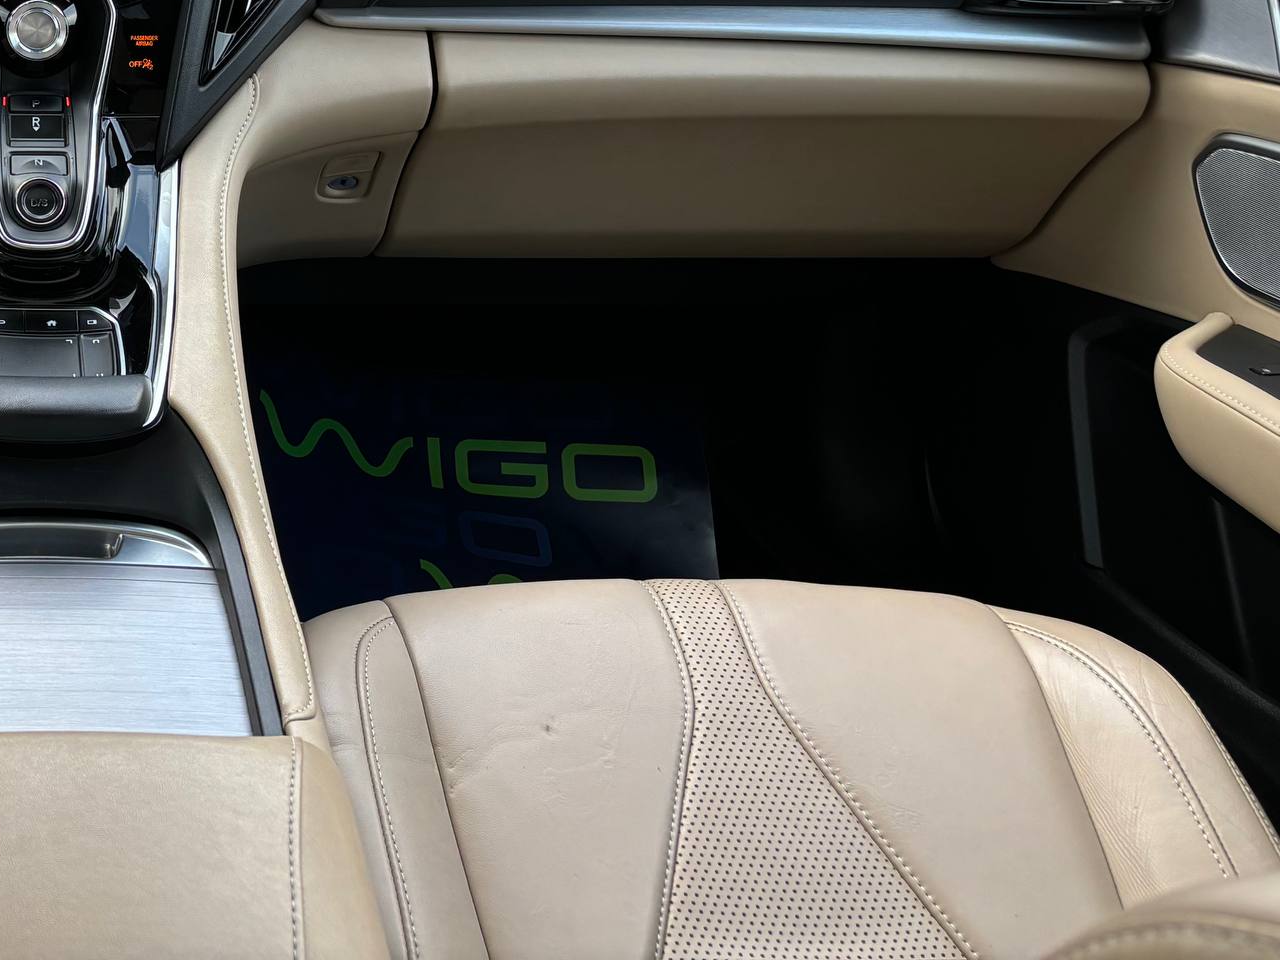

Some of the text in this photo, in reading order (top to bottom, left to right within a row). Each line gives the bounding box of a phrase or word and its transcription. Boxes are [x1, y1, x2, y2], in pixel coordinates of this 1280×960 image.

[128, 60, 143, 68] OFF
[32, 117, 41, 127] R
[30, 198, 48, 207] D/S
